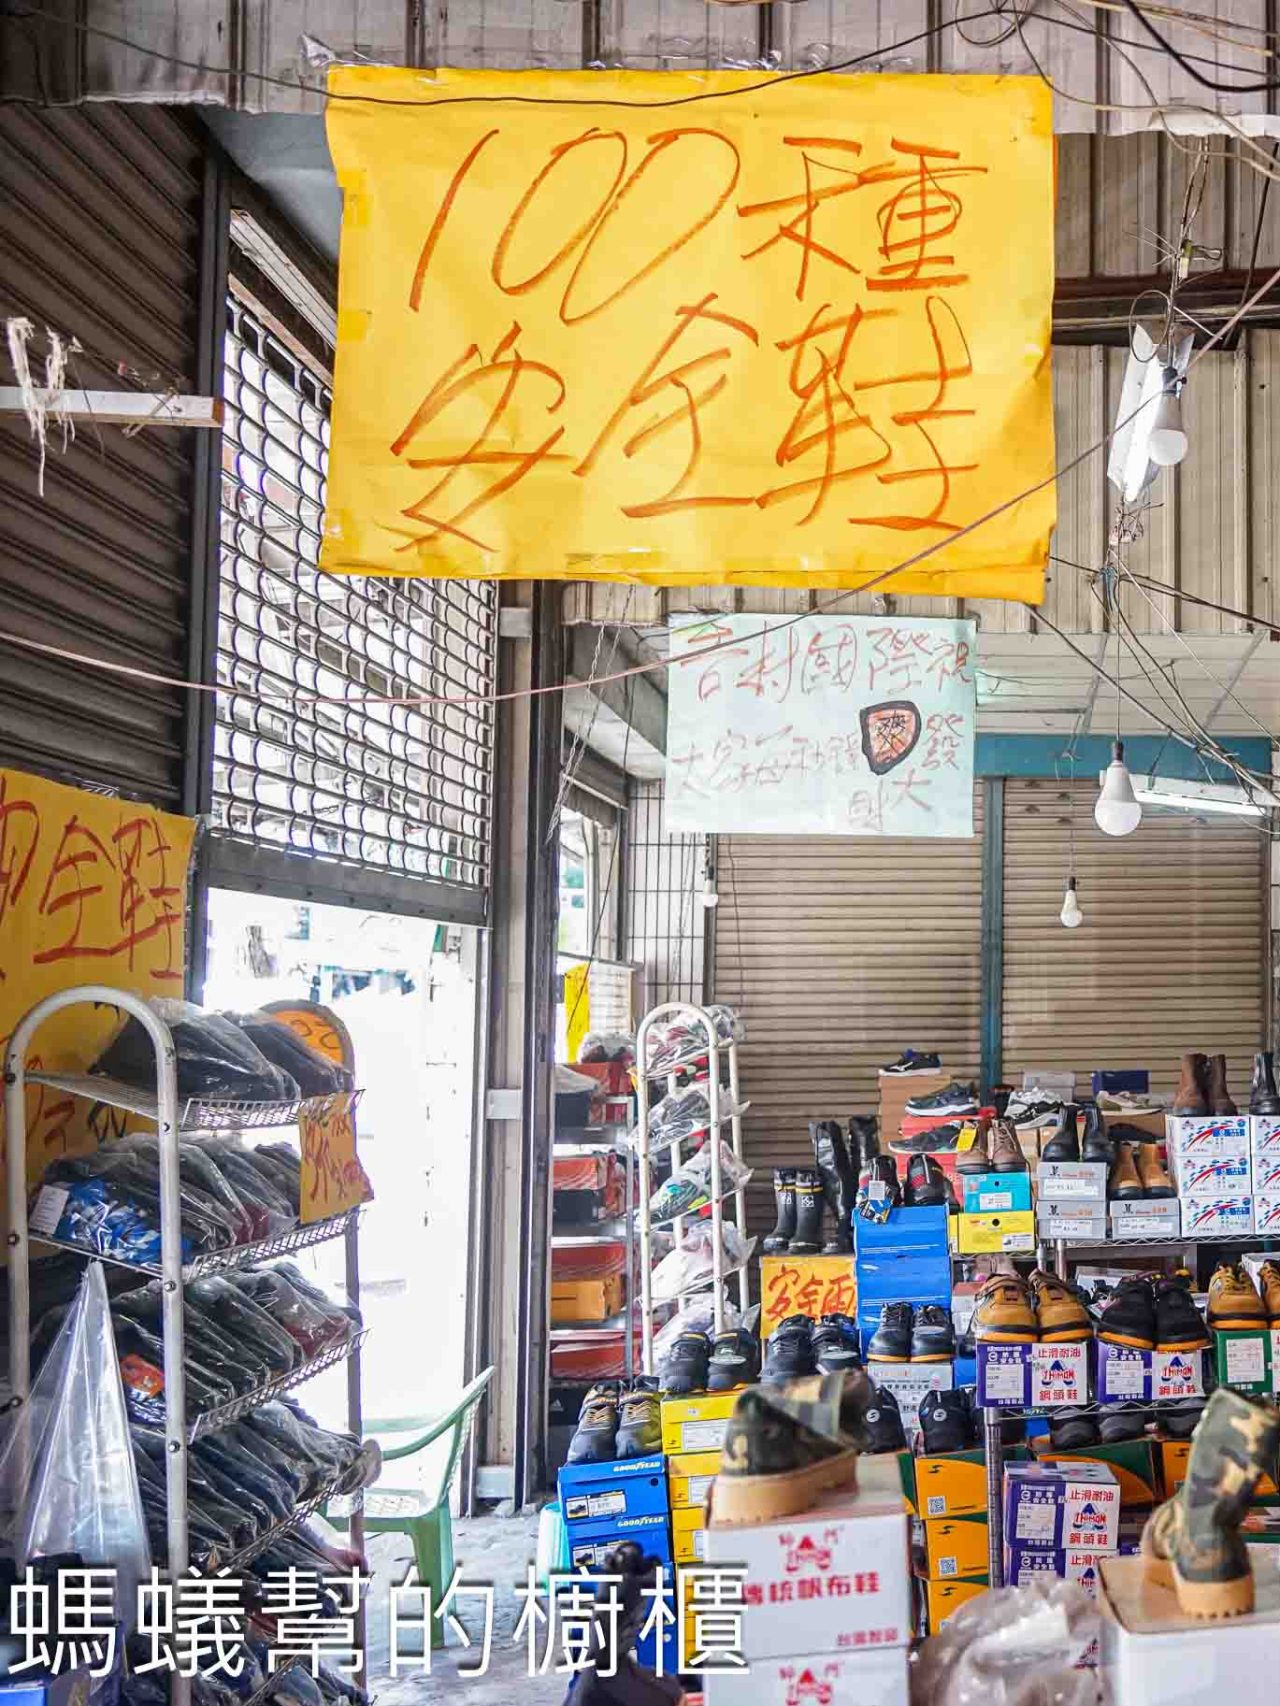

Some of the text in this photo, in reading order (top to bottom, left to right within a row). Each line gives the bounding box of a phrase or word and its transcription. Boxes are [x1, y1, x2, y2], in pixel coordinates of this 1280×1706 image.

[409, 127, 988, 324] 100種
[390, 292, 980, 552] 安全鞋
[1038, 1347, 1081, 1359] 止滑耐油
[1039, 1389, 1078, 1401] 鋼頭鞋
[1070, 1490, 1113, 1502] 止滑耐油
[1069, 1533, 1108, 1545] 鋼頭鞋
